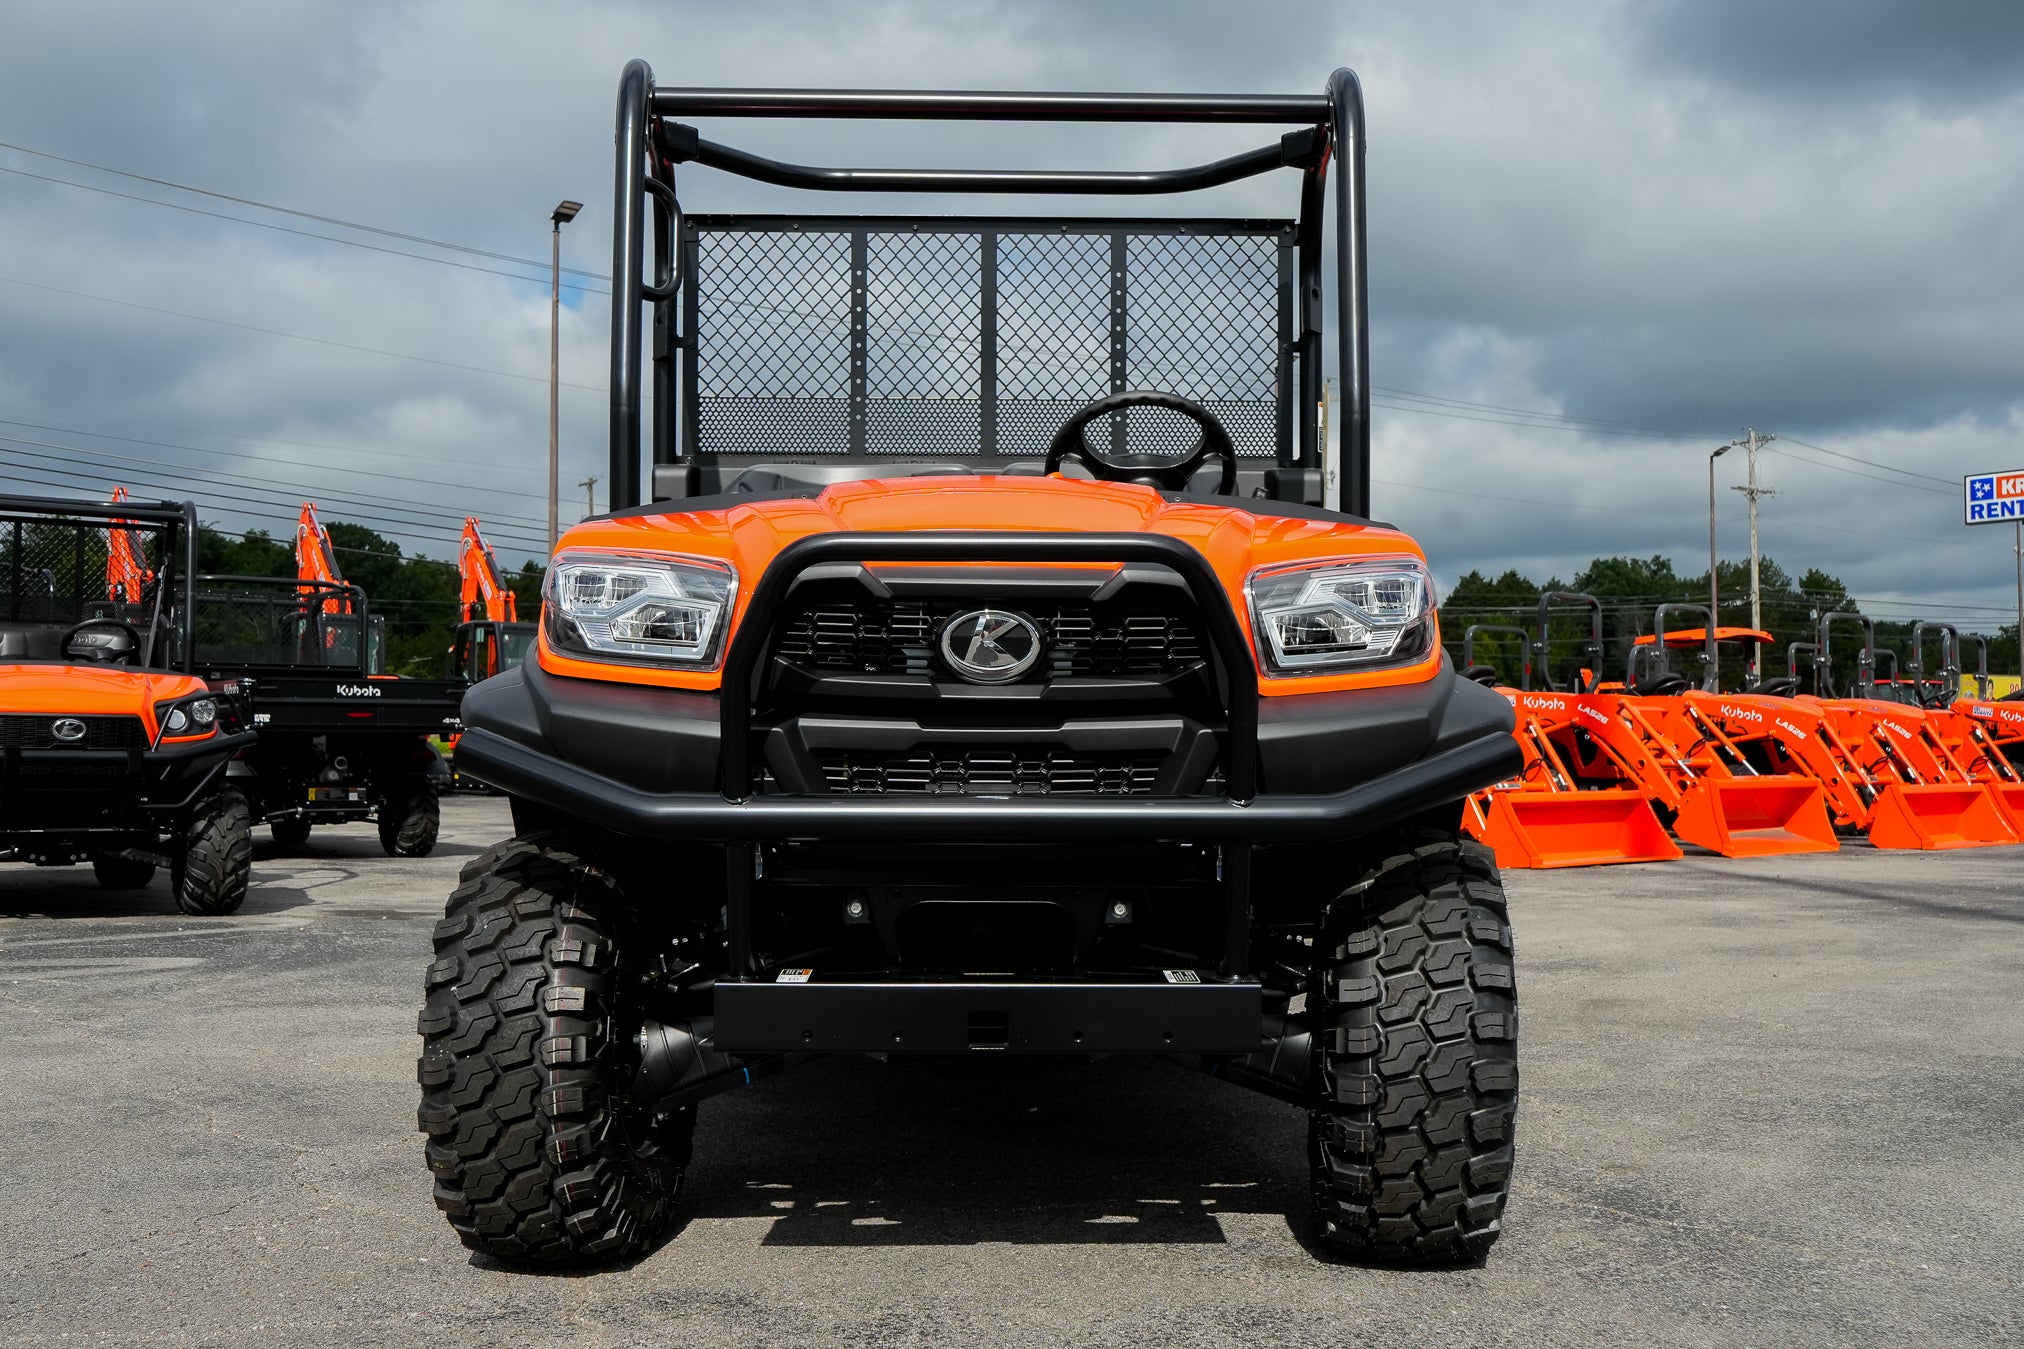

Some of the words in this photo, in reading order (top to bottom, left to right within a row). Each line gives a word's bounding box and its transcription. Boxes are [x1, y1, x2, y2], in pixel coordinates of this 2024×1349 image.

[336, 684, 382, 697] Kubota
[1523, 696, 1566, 711] Kubota
[1577, 703, 1609, 725] LA526
[1720, 704, 1763, 723] Kubota
[2000, 709, 2024, 723] Kub
[1775, 717, 1807, 740] LA526
[1882, 718, 1913, 740] LA526
